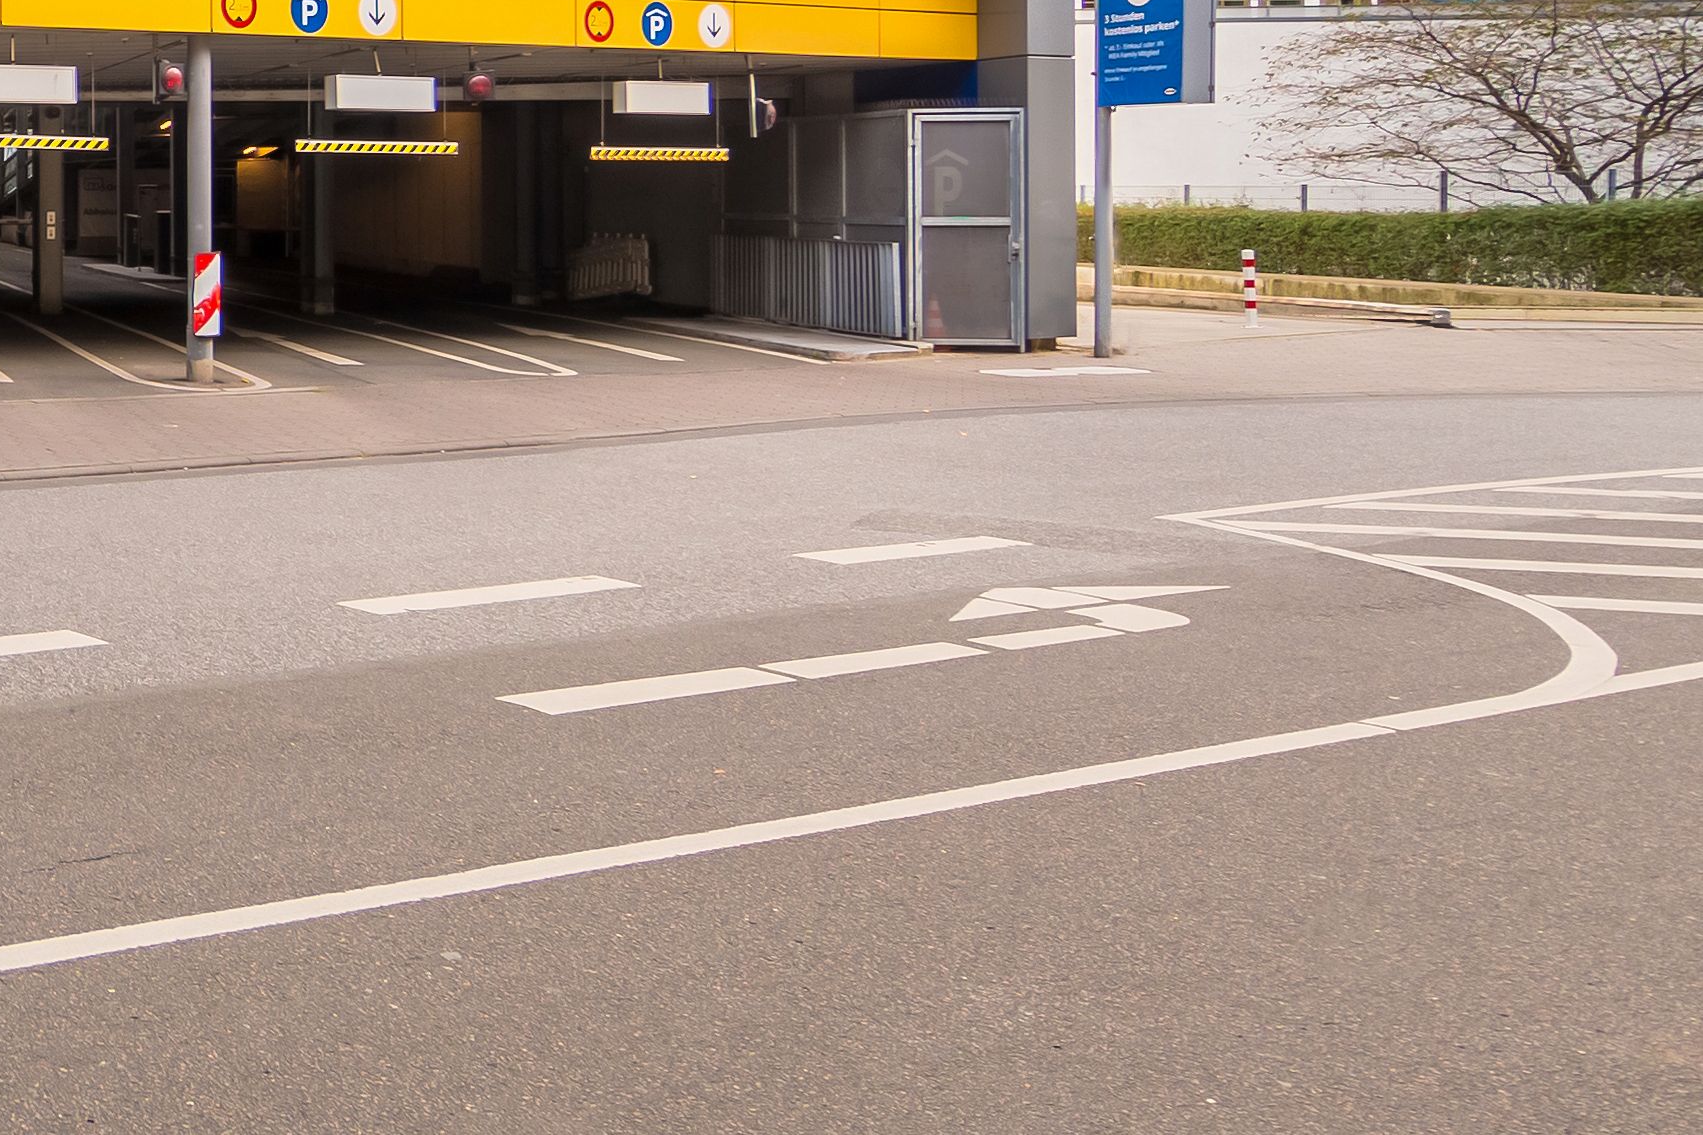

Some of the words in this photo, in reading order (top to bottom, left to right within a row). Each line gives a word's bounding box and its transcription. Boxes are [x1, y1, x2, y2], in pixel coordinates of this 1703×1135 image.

[301, 0, 319, 26] P
[1104, 14, 1110, 24] 3
[1110, 11, 1145, 23] Stunden
[649, 15, 666, 40] P
[1103, 24, 1144, 37] kostenlos
